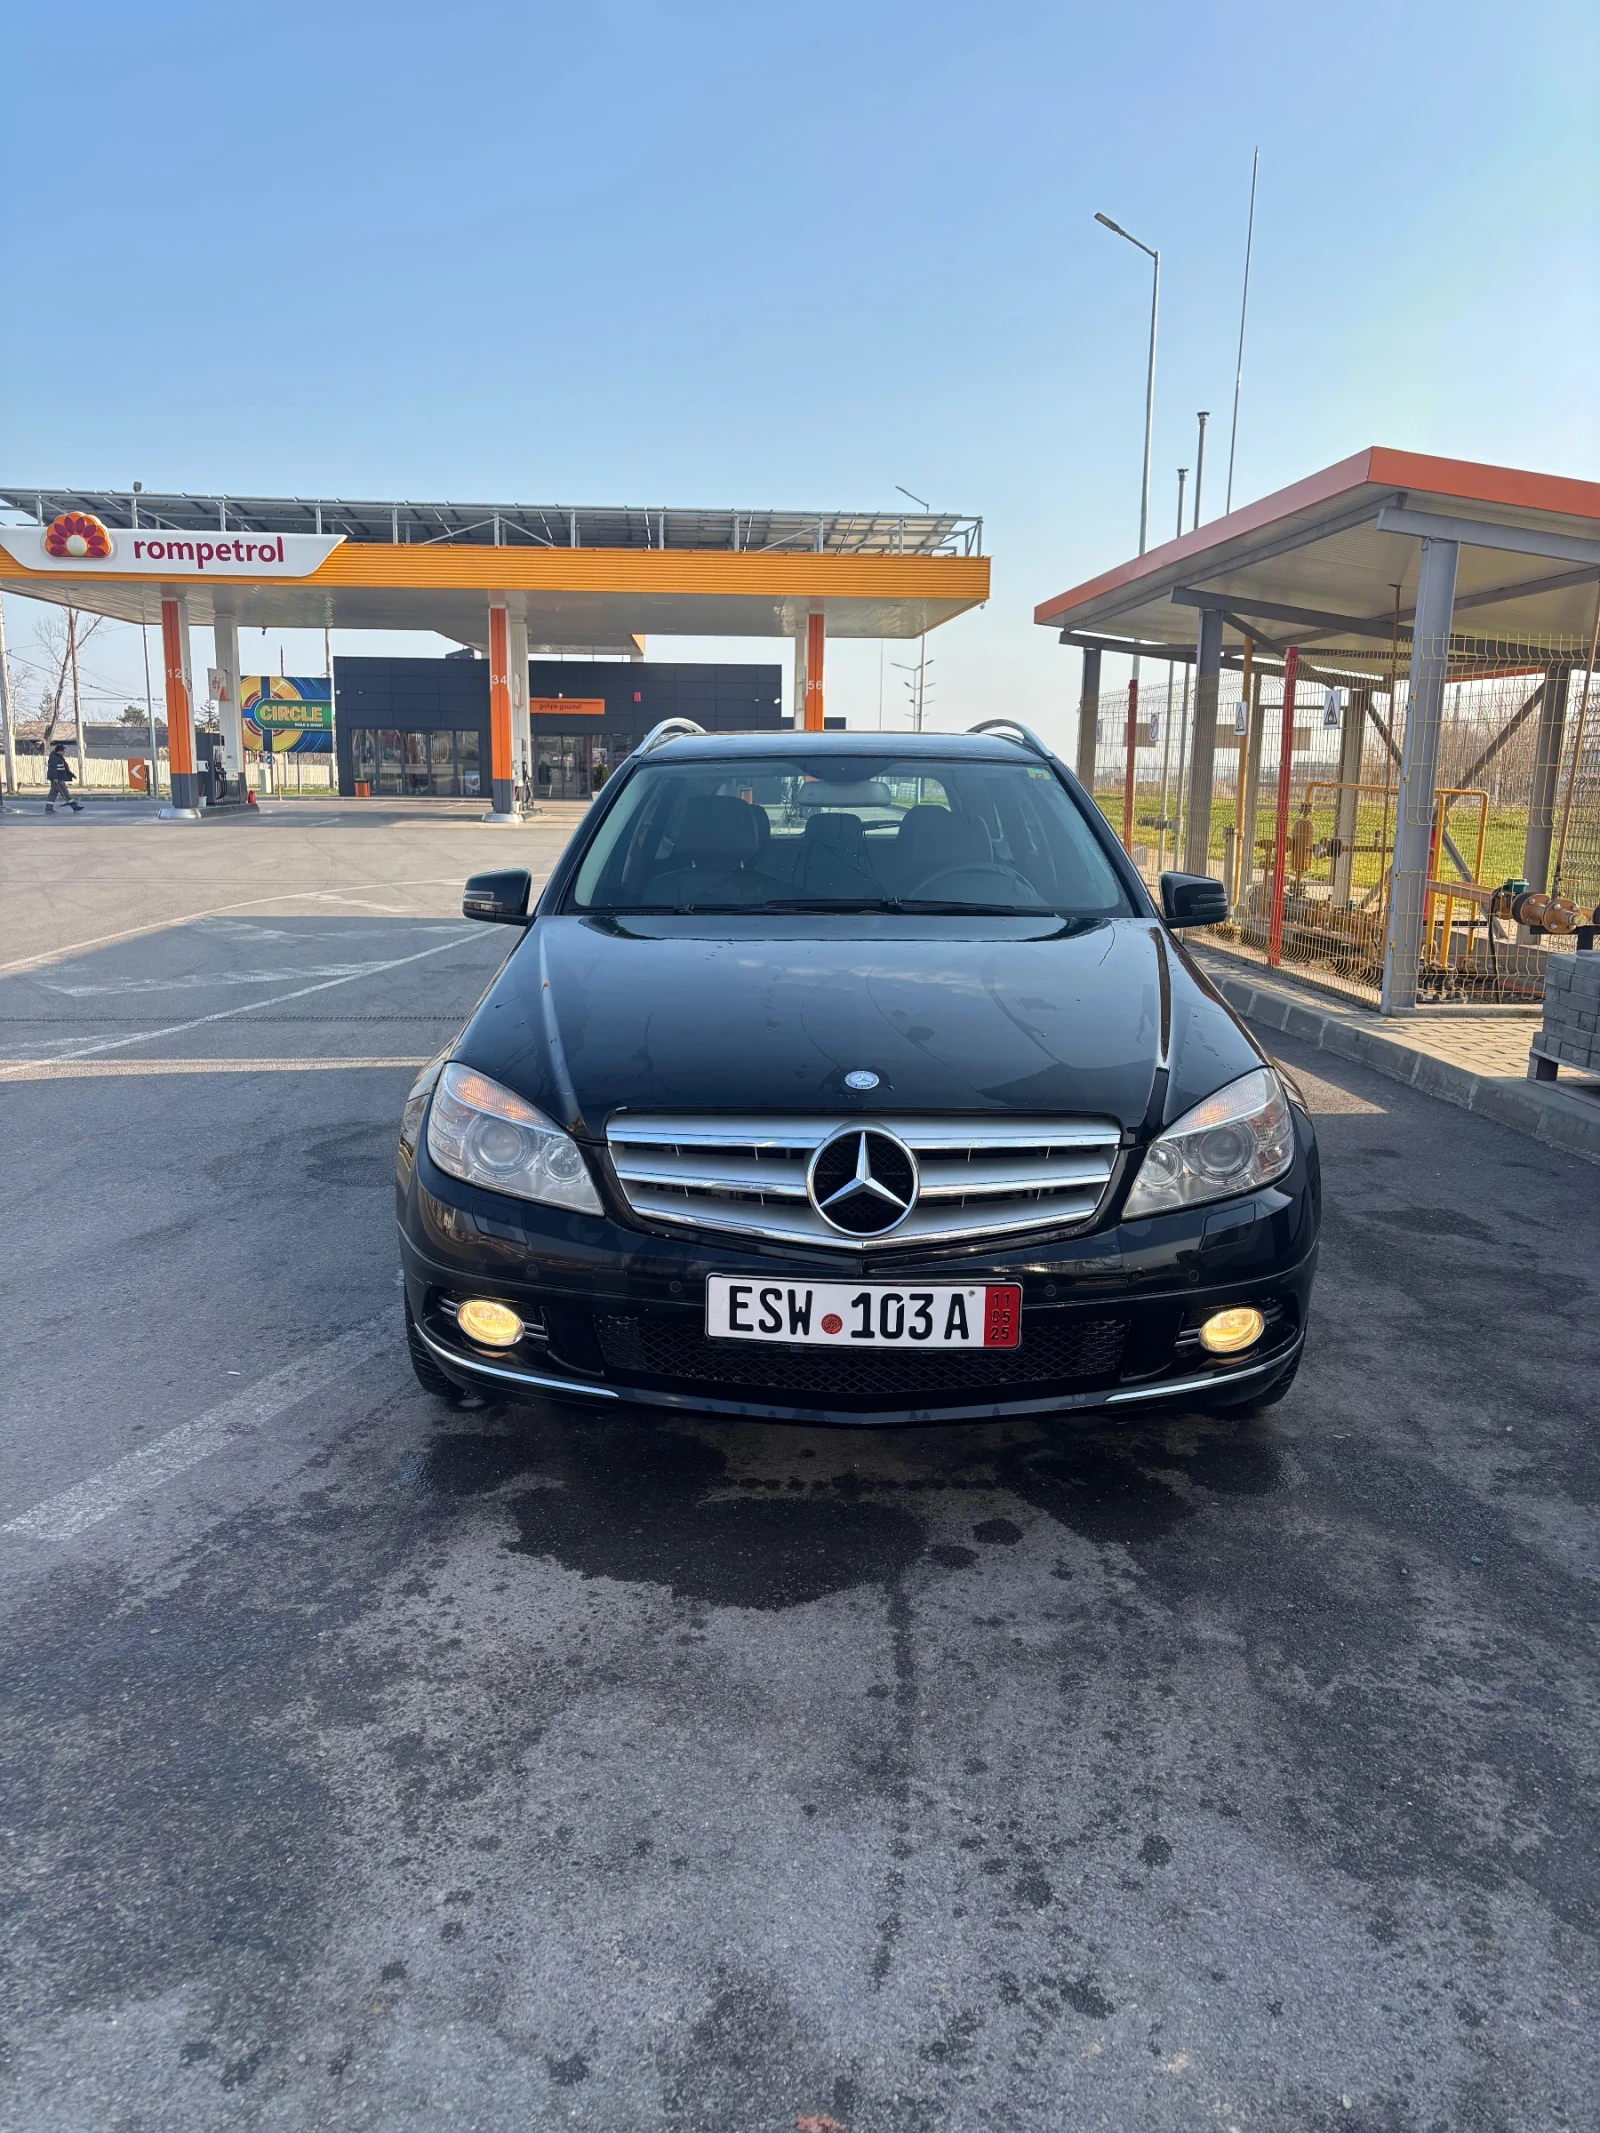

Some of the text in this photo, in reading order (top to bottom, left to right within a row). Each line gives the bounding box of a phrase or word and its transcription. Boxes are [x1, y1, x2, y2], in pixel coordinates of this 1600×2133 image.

[133, 536, 284, 569] rompetrol
[260, 705, 323, 722] CIRCLE
[993, 1292, 1010, 1307] 11
[729, 1285, 813, 1336] ESW
[850, 1292, 934, 1340] 103
[944, 1293, 970, 1340] A
[991, 1308, 1011, 1323] 05
[990, 1325, 1010, 1340] 25
